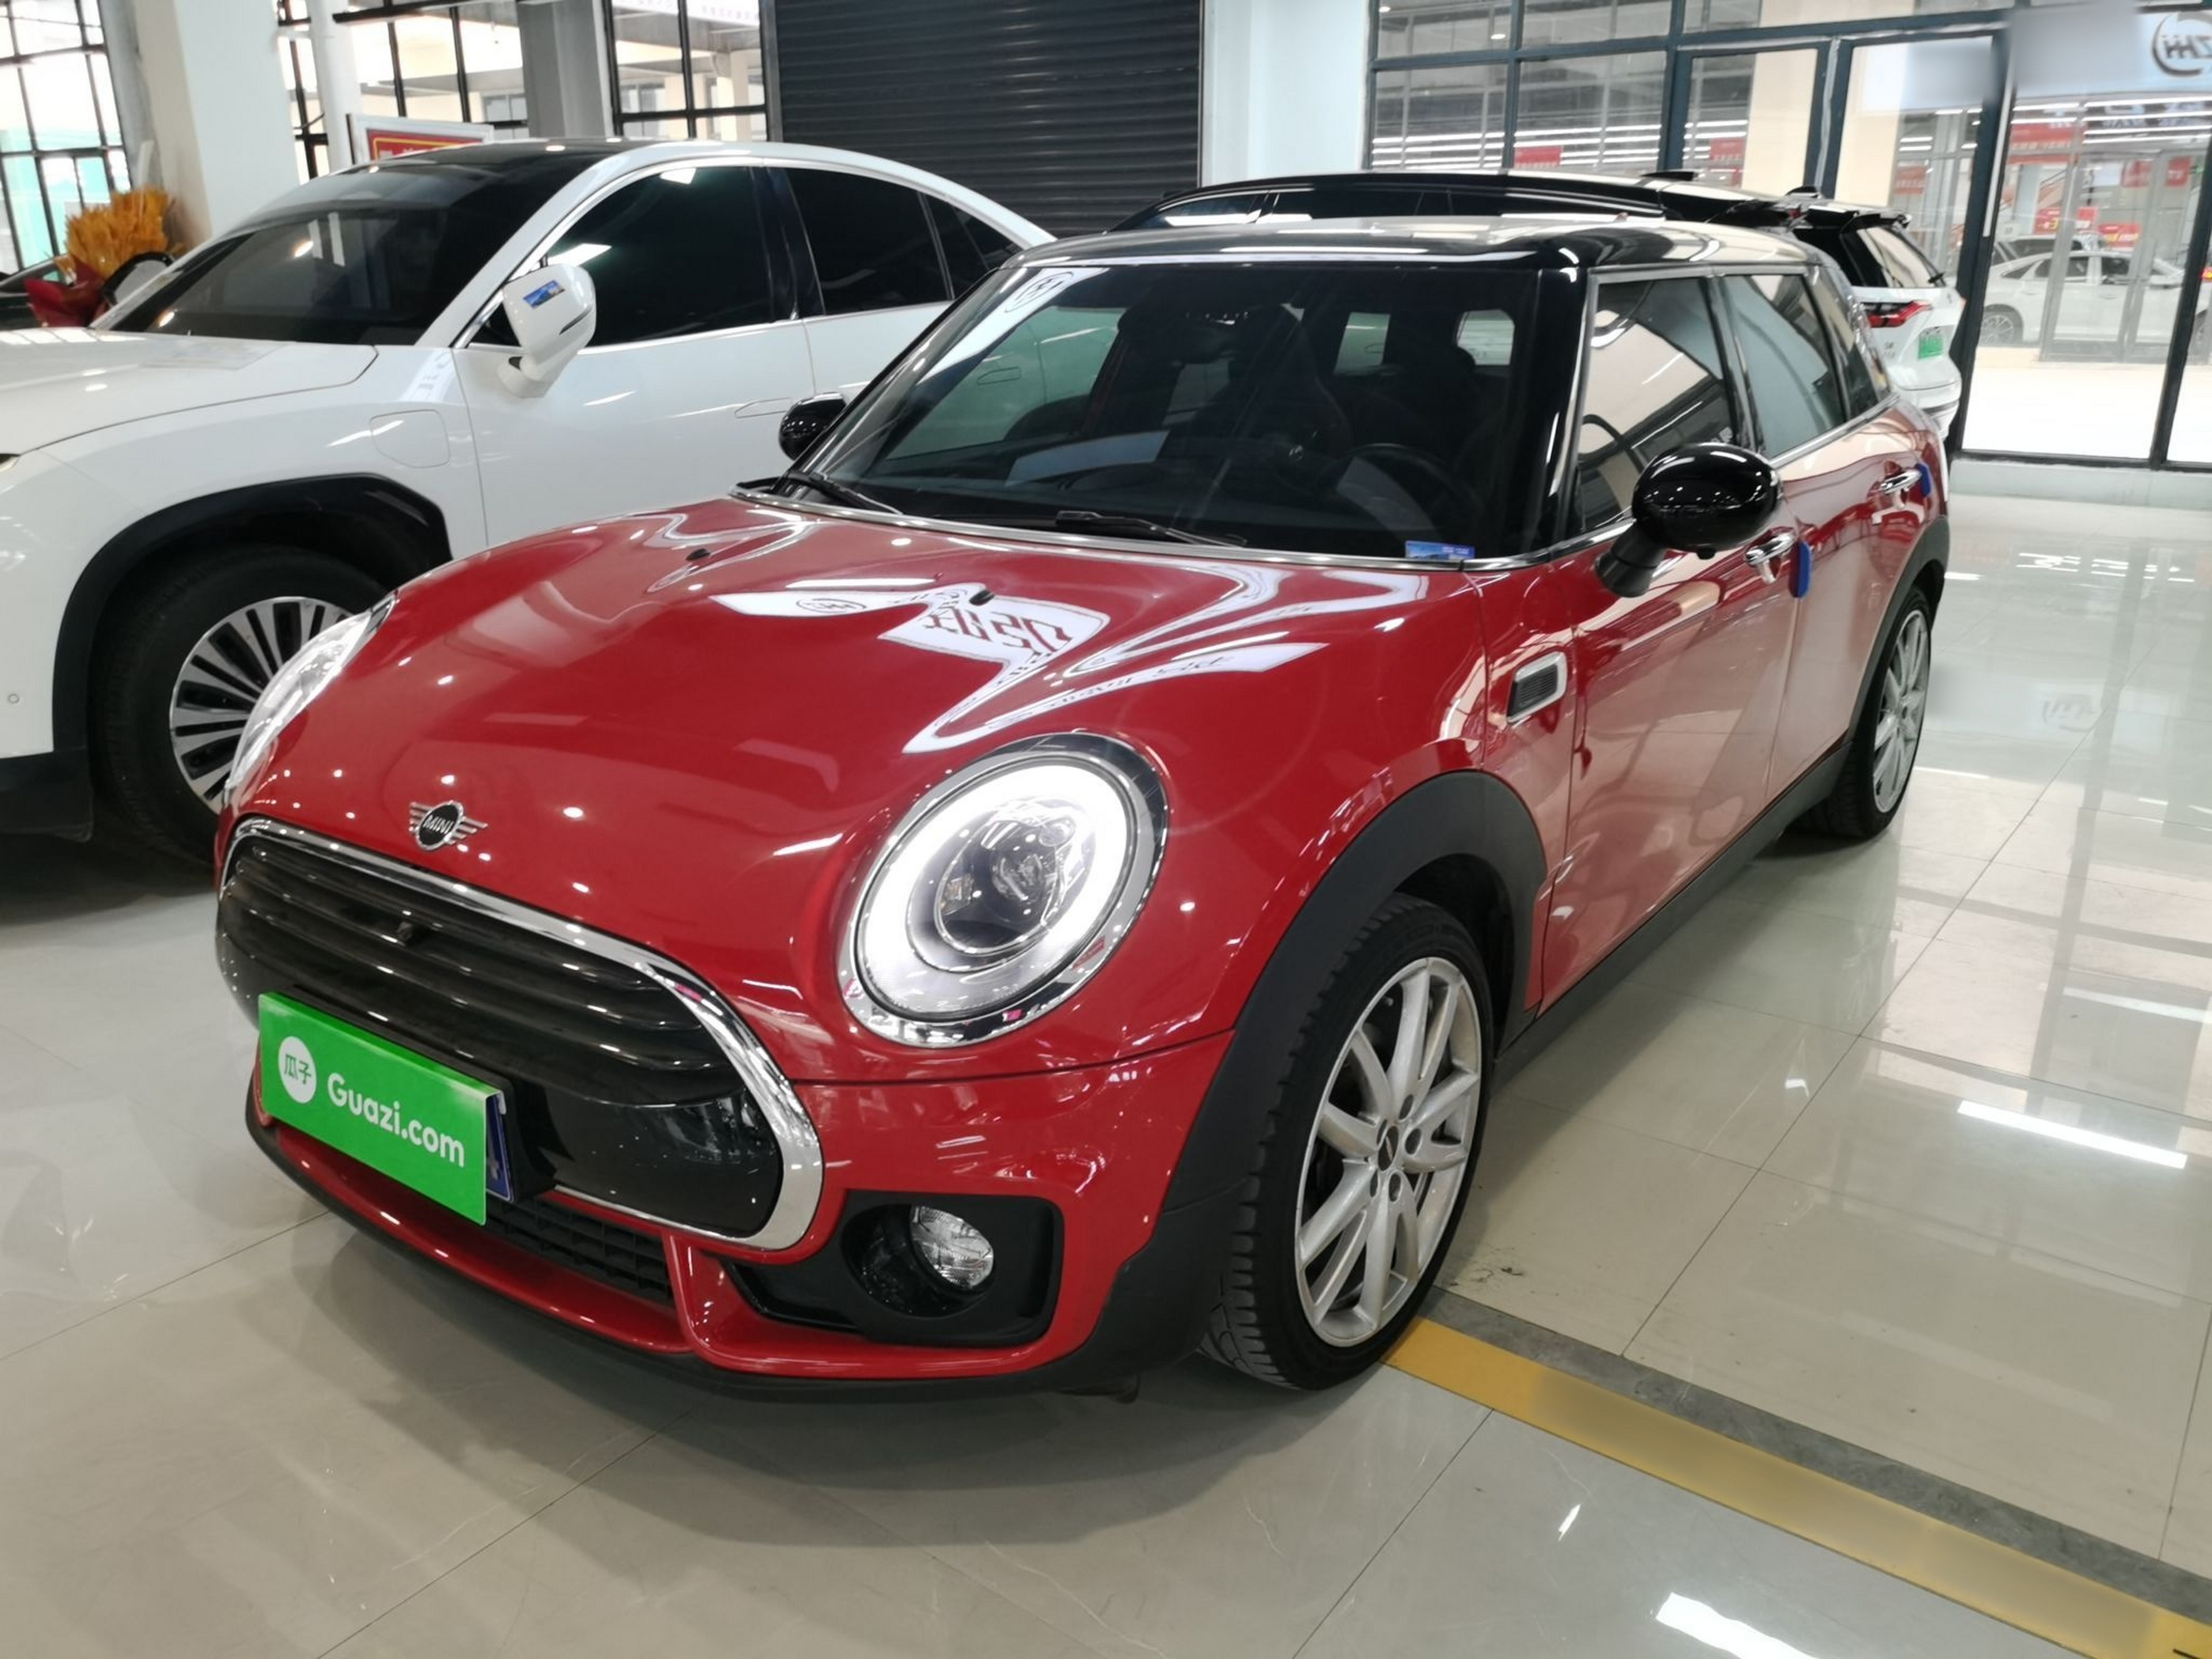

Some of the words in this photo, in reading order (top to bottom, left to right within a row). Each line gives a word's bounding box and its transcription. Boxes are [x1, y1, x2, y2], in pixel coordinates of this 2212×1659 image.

[422, 815, 454, 835] MINI
[285, 1054, 312, 1085] 瓜子
[327, 1072, 464, 1168] Guazi.com
